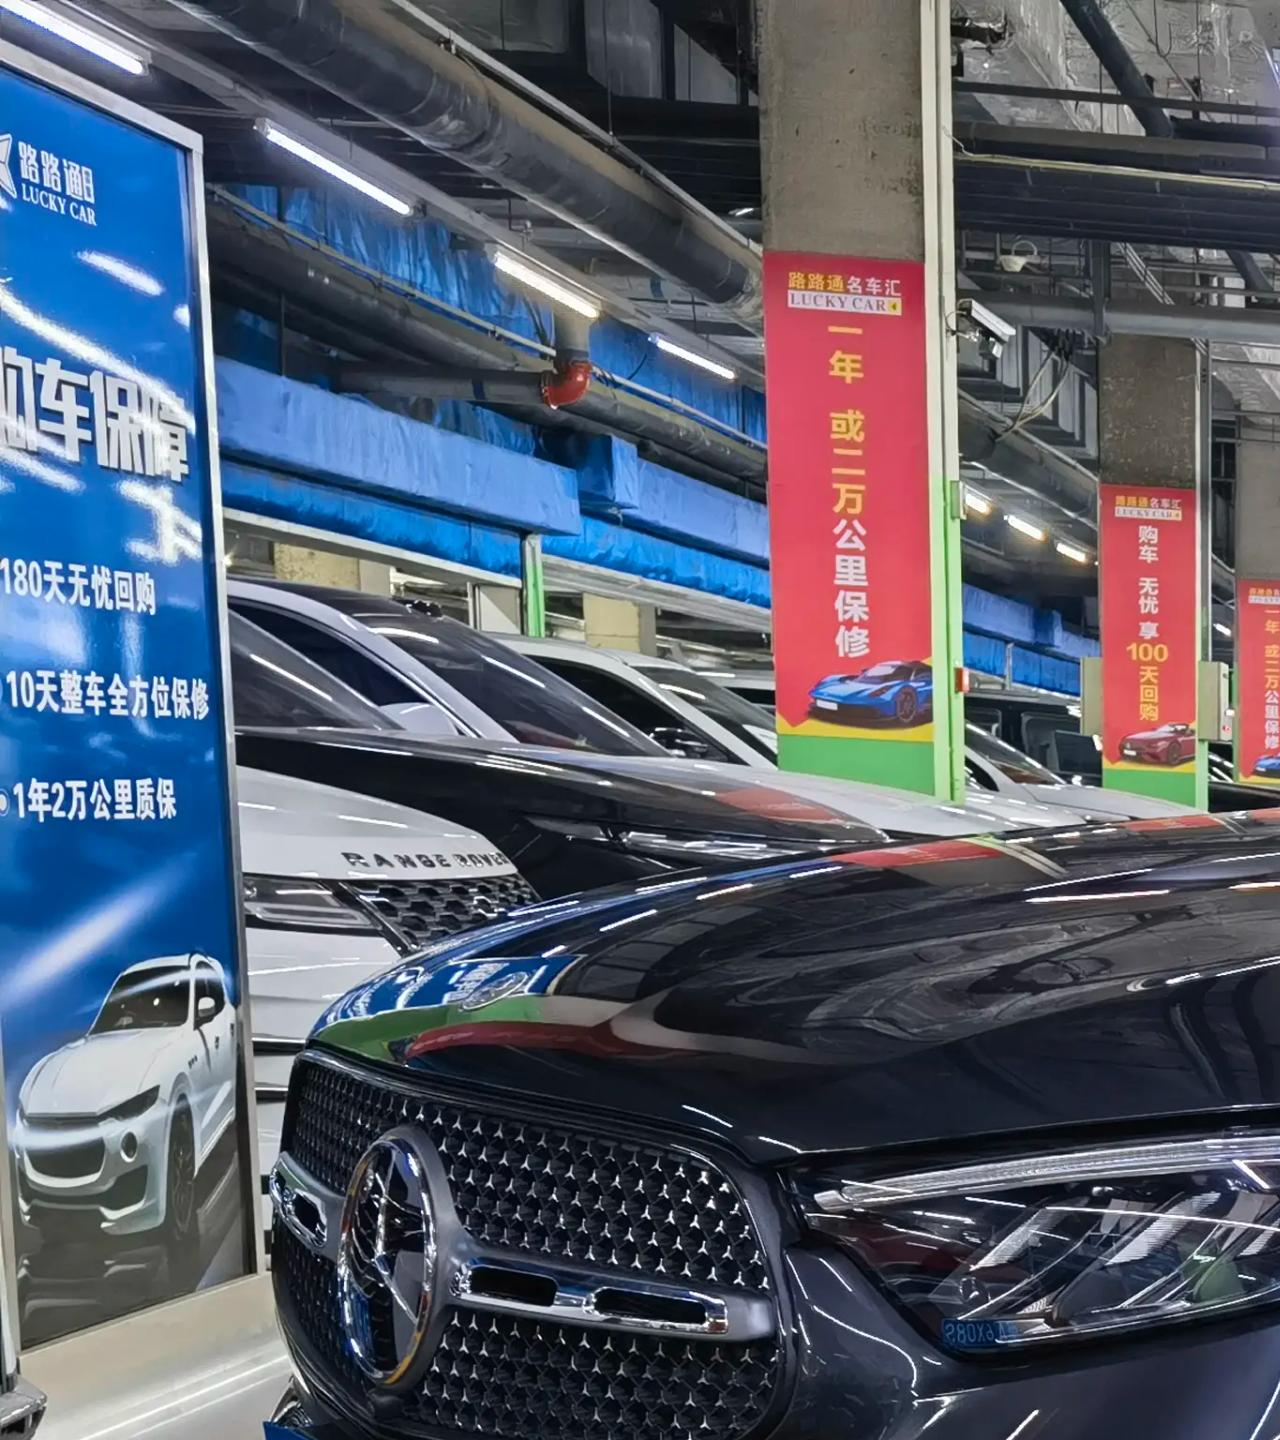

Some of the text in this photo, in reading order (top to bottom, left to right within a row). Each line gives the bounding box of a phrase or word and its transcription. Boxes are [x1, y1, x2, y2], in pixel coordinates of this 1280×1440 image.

[21, 182, 66, 215] LUCKY
[69, 201, 98, 226] CAR
[788, 271, 902, 296] 路路通名车汇
[789, 292, 887, 312] LUCKY CAR
[0, 557, 155, 616] 180天无忧回购
[6, 669, 210, 720] 10天整车全方位保修
[13, 777, 177, 823] 1年2万公里质保
[341, 852, 452, 868] RANGE
